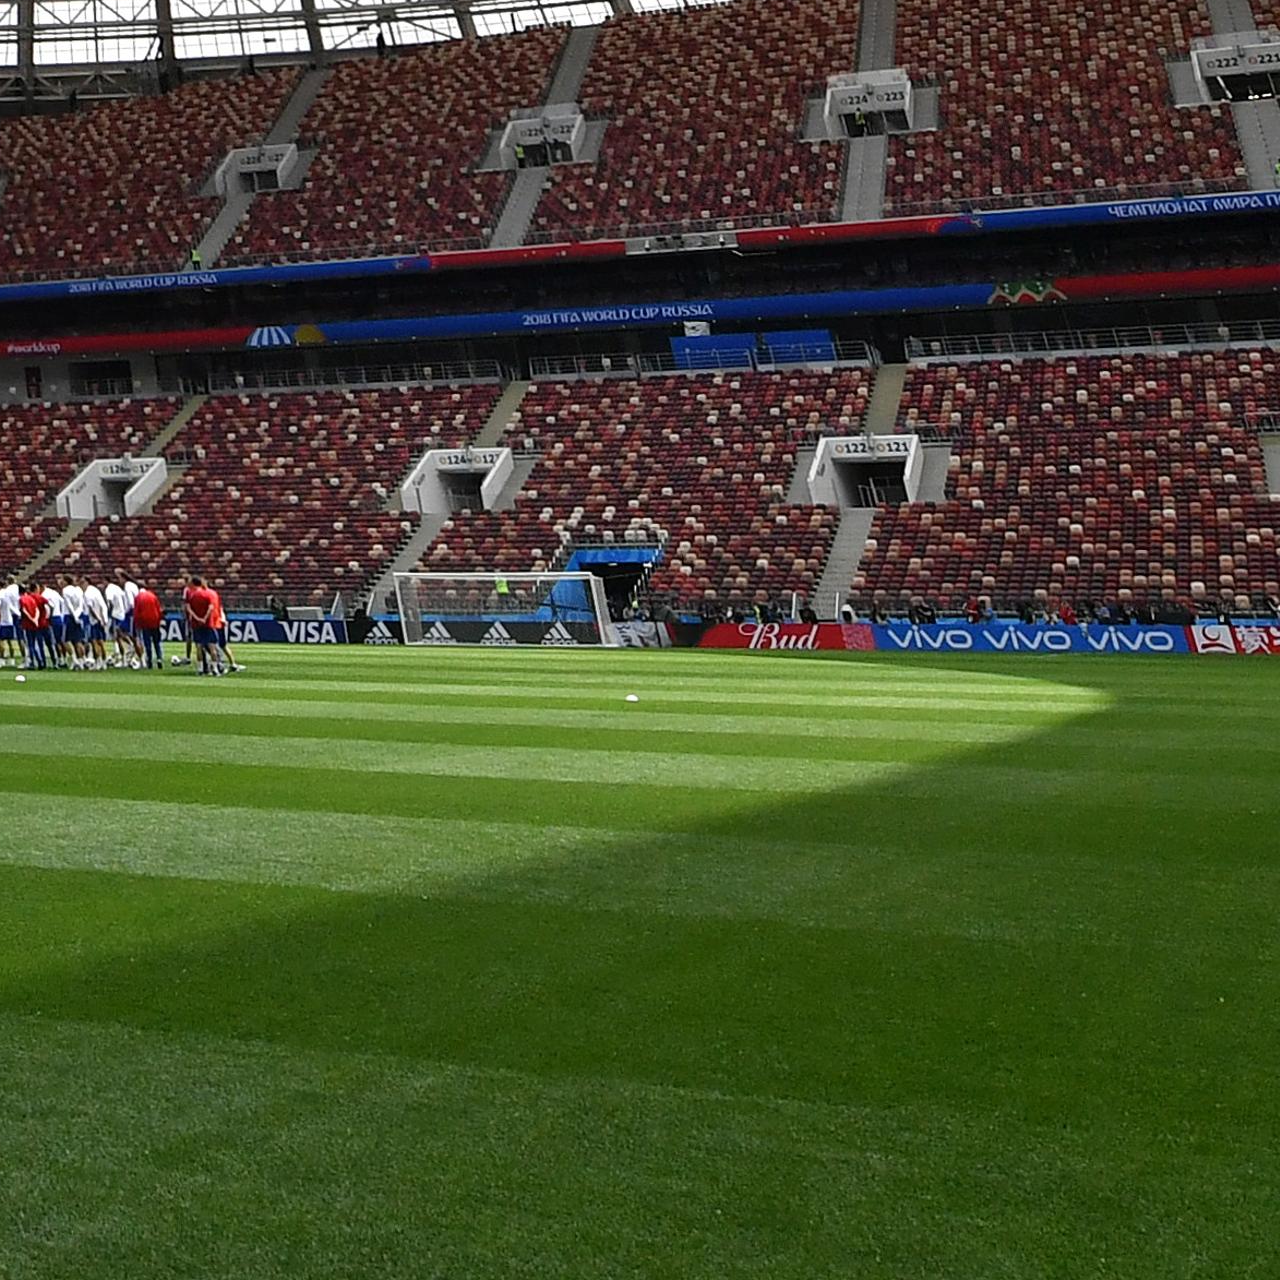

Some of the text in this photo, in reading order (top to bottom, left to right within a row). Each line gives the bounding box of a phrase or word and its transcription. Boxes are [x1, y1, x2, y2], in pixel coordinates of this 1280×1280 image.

[1216, 58, 1238, 68] 222
[848, 91, 904, 105] 224 223
[1108, 193, 1280, 218] ЧЕМПИОНАТ МИРА П
[92, 280, 114, 292] FIFA
[115, 277, 153, 290] WORLD
[153, 276, 176, 287] CUP
[177, 273, 218, 285] RUSSIA
[522, 304, 713, 326] 2018 FIFA WORLD CUP RUSSIA
[7, 341, 61, 355] #worldcup
[844, 439, 910, 453] 122 121
[278, 620, 337, 642] VISA
[738, 622, 821, 649] Bud
